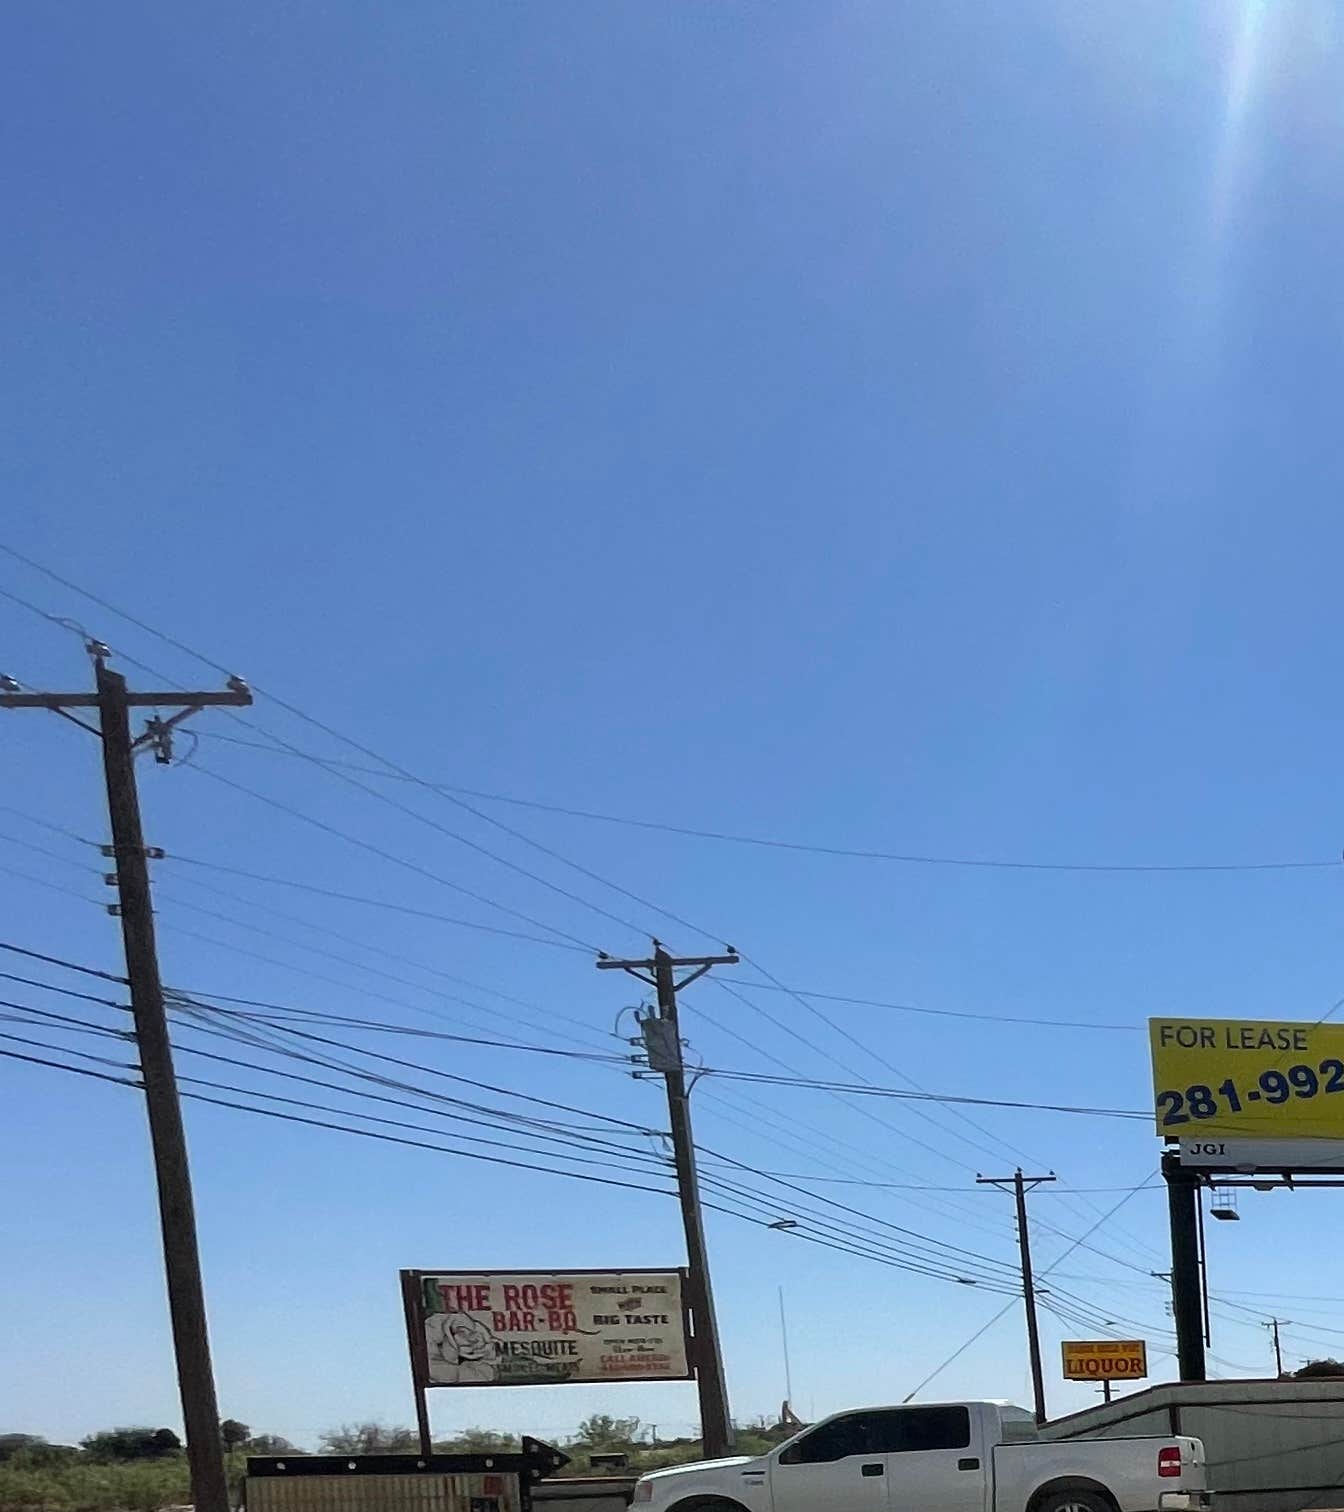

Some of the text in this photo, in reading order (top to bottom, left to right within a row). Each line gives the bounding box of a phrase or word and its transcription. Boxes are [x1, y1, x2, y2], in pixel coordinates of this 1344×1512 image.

[1160, 1026, 1308, 1050] FOR LEASE
[1190, 1144, 1226, 1155] JGI
[438, 1284, 574, 1312] THE ROSE
[593, 1314, 669, 1325] BIG TASTE
[495, 1339, 579, 1357] MESQUITE
[1067, 1358, 1143, 1376] LIQUOR
